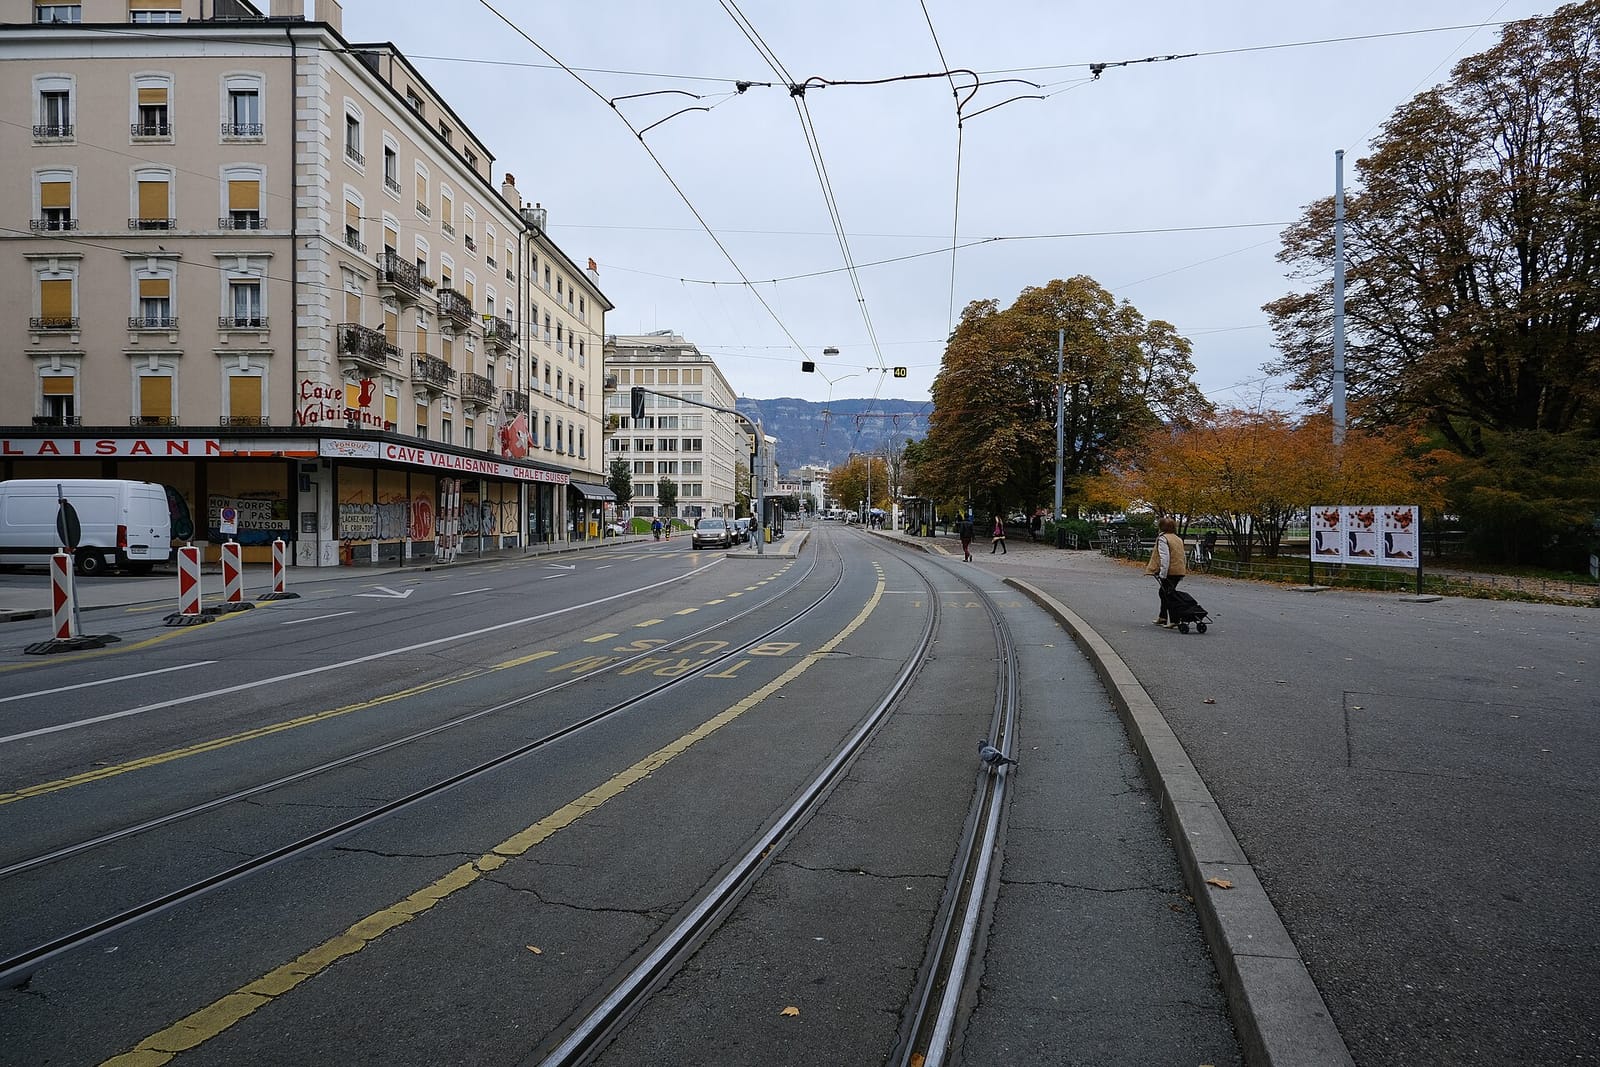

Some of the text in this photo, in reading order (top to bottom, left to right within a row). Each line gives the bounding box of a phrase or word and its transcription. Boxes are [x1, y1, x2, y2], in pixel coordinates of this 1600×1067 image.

[895, 368, 906, 377] 40
[301, 379, 343, 401] Cave
[295, 401, 391, 431] Valaisanne
[386, 445, 569, 485] CAVE VALAISANNE CHALET SUISSE
[237, 501, 272, 510] CORPS
[251, 511, 272, 520] PAS
[613, 638, 801, 656] BUS
[546, 655, 752, 679] TRAM
